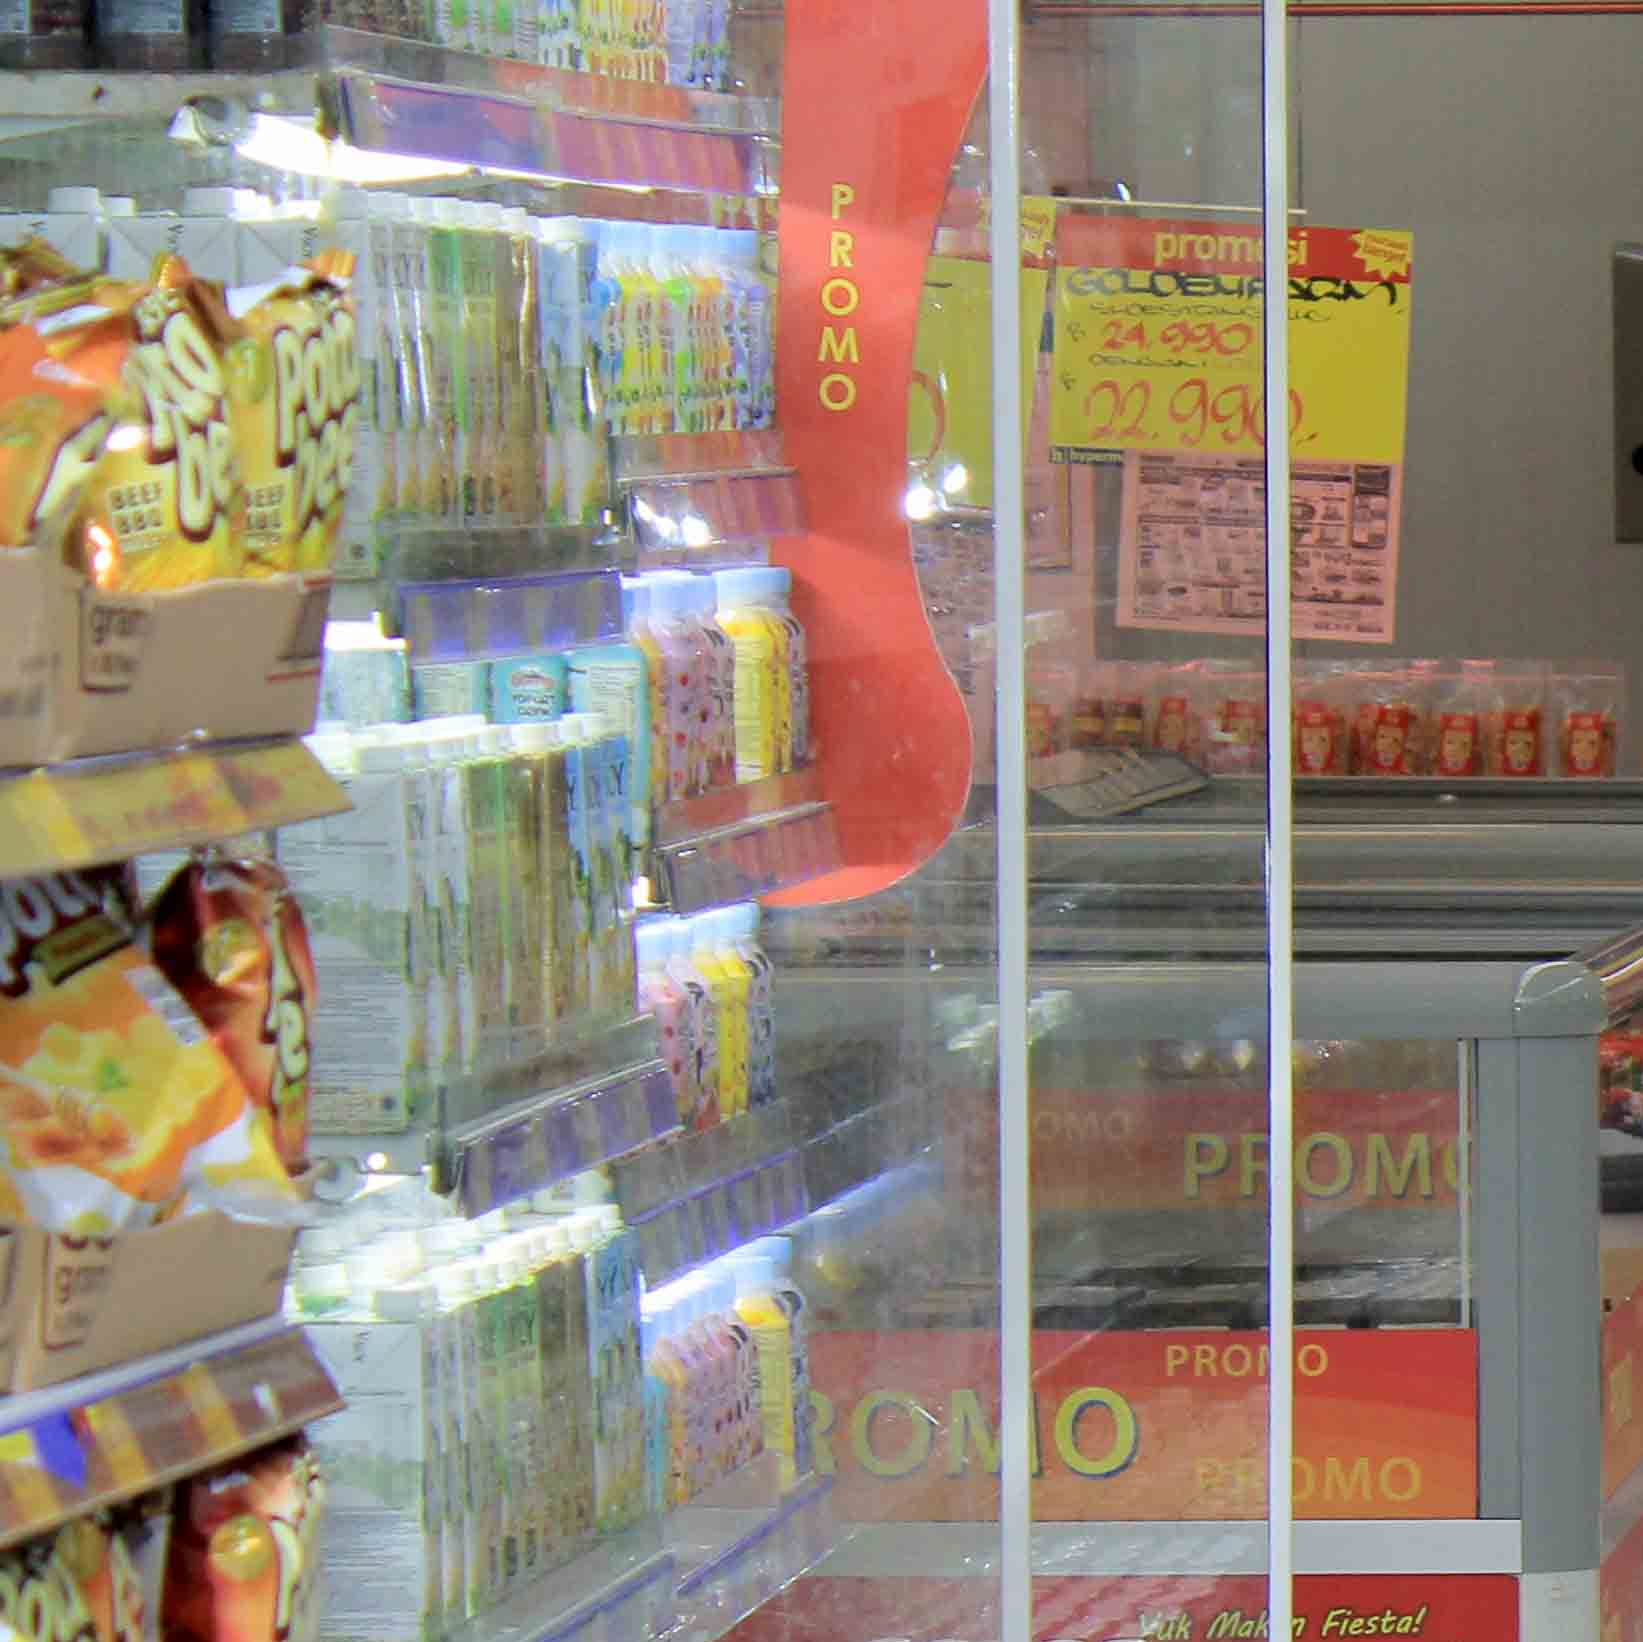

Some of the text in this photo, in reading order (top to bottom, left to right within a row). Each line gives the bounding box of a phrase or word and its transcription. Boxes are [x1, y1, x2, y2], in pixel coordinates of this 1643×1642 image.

[818, 183, 861, 412] PROMO
[1205, 1608, 1306, 1642] Makn
[1321, 1604, 1427, 1638] Fiesta!
